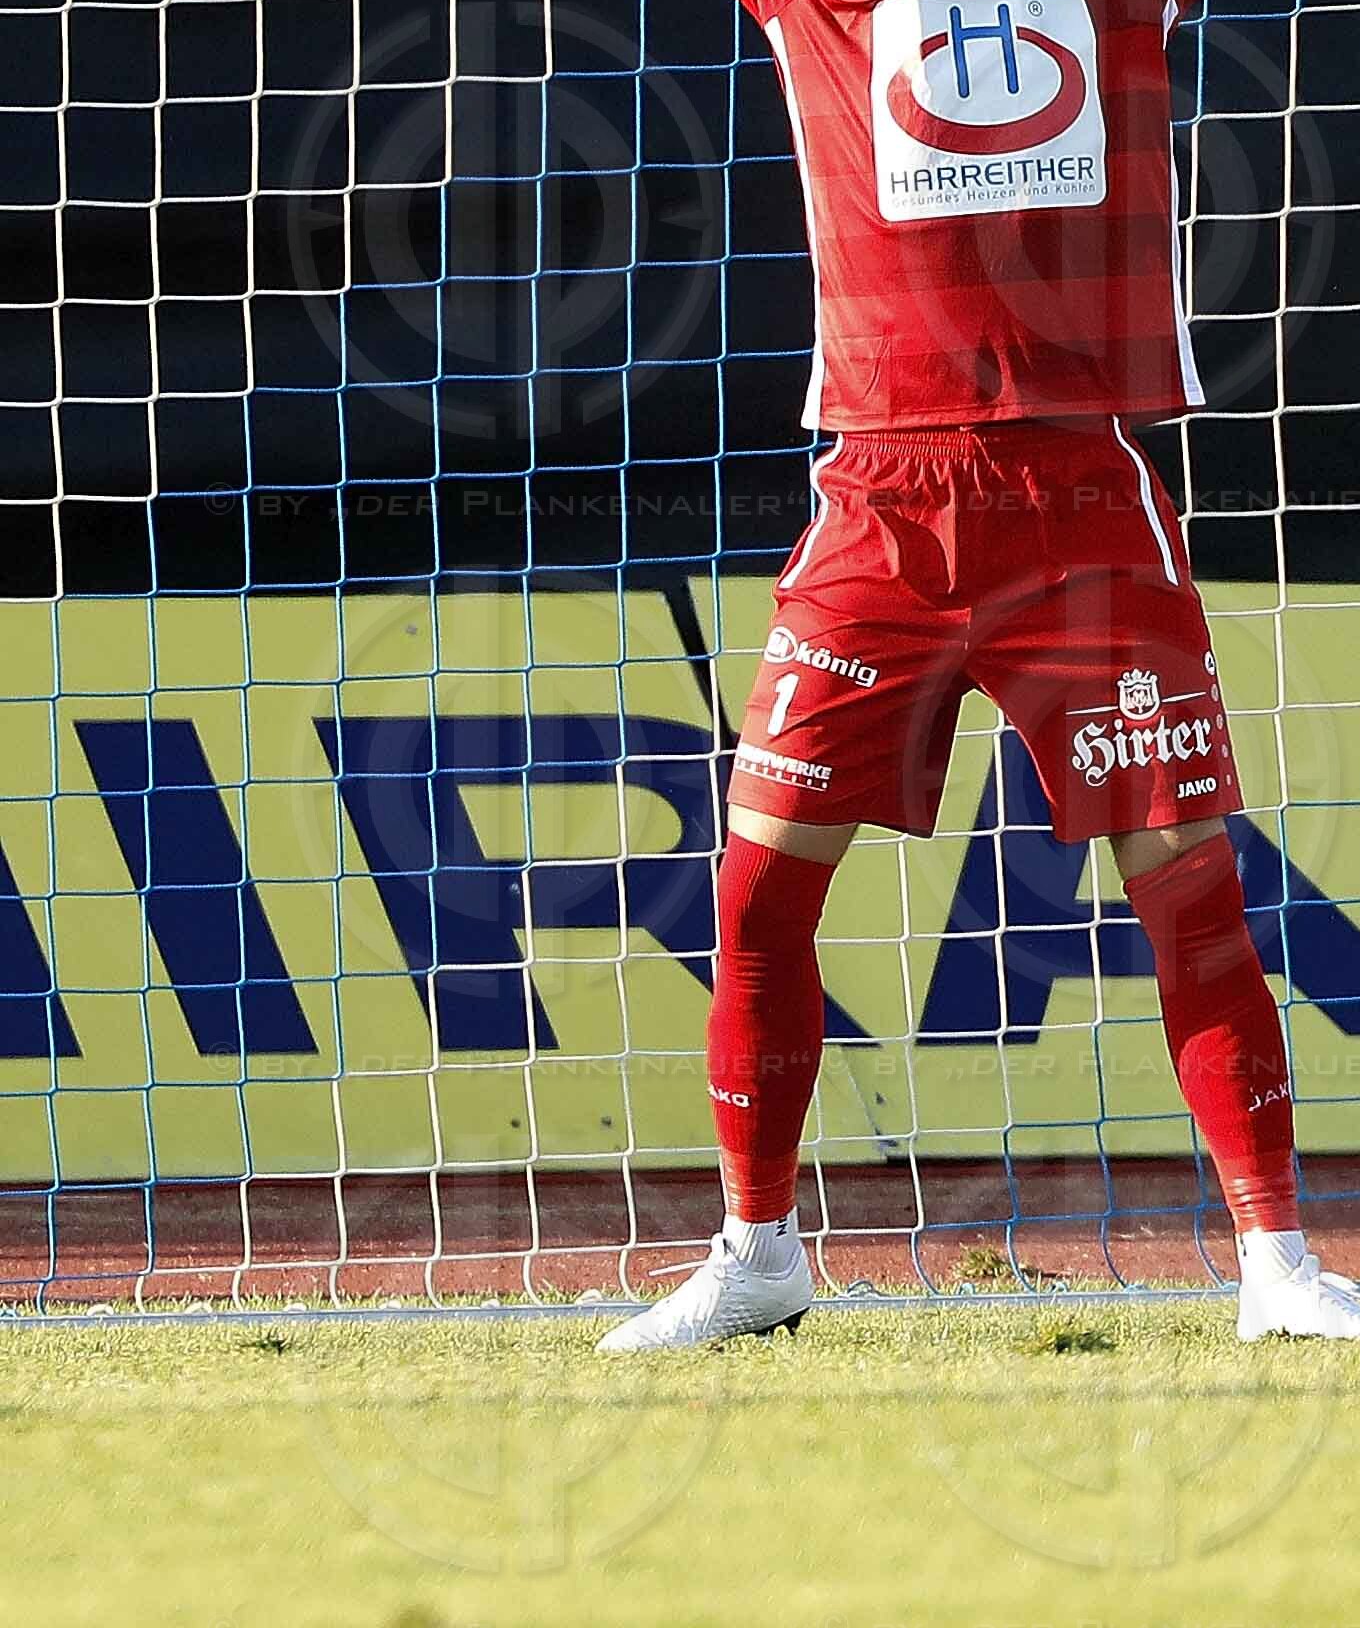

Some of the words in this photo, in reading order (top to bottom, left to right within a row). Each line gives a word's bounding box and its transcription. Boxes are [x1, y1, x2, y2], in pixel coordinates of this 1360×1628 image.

[890, 155, 1096, 195] HARREITHER
[966, 186, 1017, 202] Heizen
[794, 640, 879, 689] könig
[767, 672, 800, 737] 1
[1176, 776, 1218, 800] JAKO
